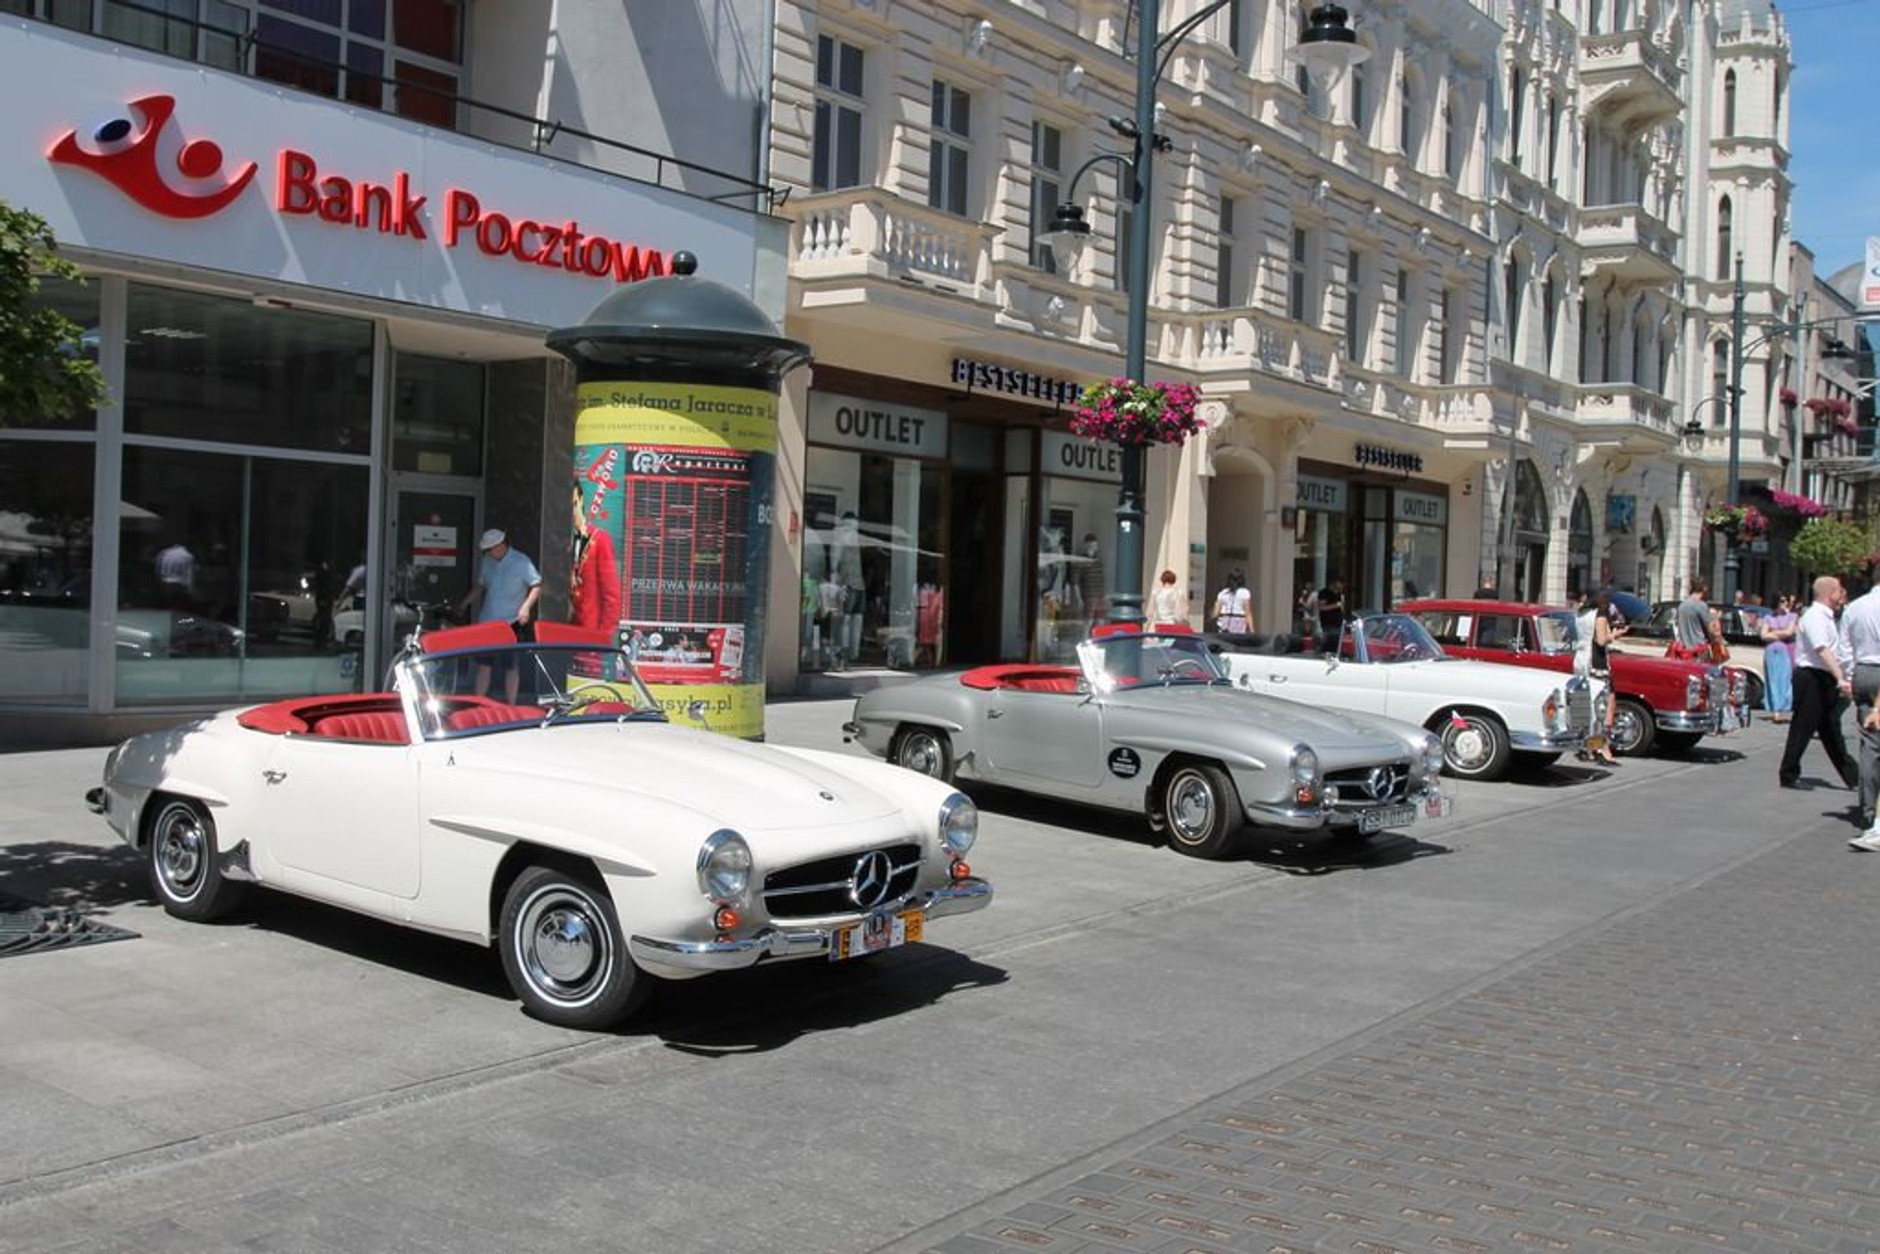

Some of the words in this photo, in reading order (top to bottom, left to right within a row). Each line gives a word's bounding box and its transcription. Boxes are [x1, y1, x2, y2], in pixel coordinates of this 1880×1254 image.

[277, 149, 427, 240] Bank
[611, 392, 681, 411] Stefana
[686, 395, 753, 417] Jaracza
[835, 406, 925, 446] OUTLET
[1403, 497, 1438, 518] OUTLET
[631, 578, 685, 591] PRZERWA
